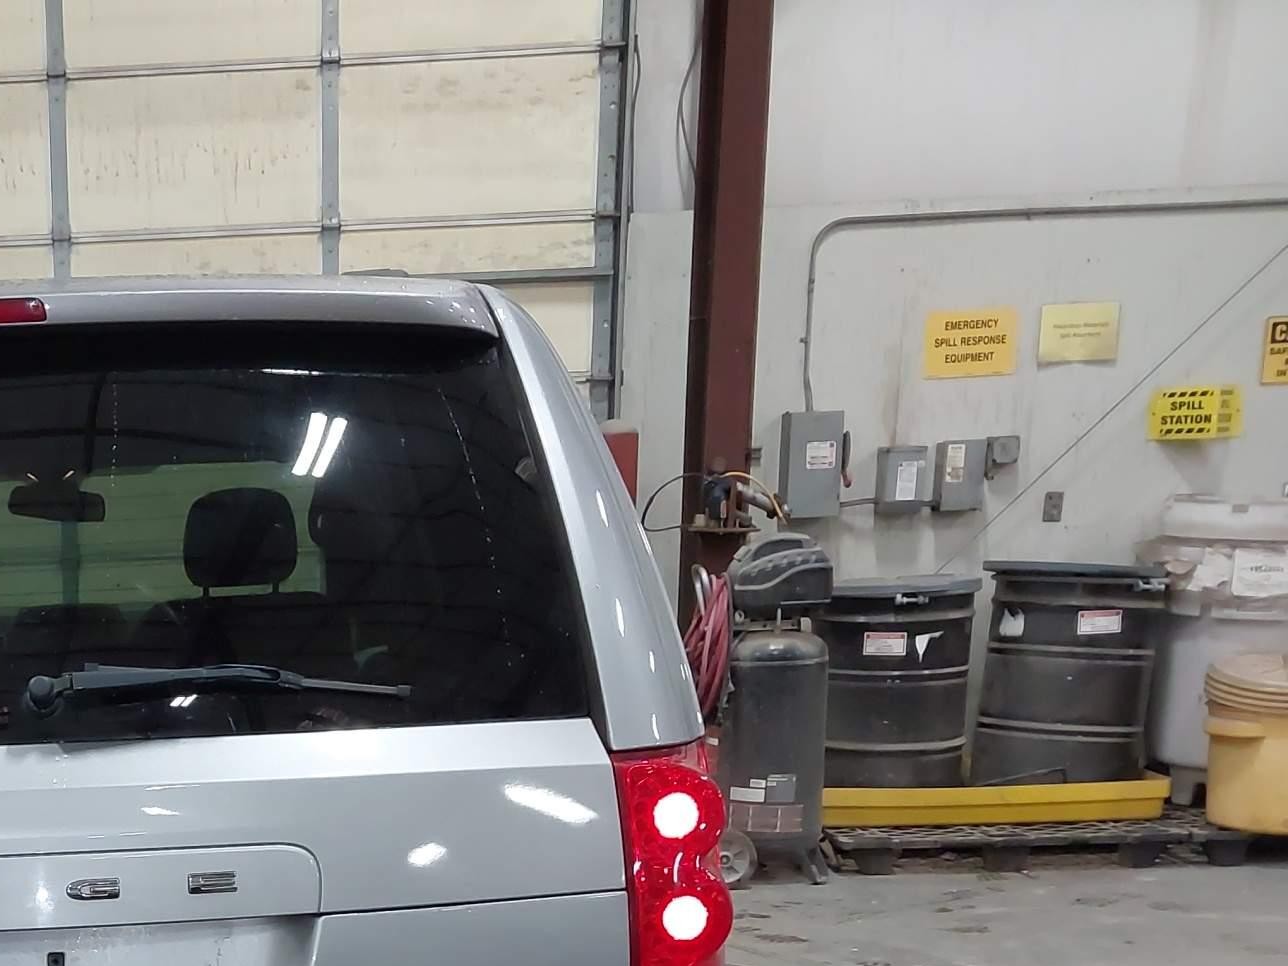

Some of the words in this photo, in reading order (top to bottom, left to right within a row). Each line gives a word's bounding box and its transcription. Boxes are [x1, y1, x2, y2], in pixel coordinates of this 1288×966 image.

[944, 318, 999, 331] EMERGENCY
[1274, 324, 1288, 341] C
[934, 336, 959, 348] SPILL
[961, 334, 1007, 347] RESPONSE
[944, 351, 994, 363] EQUIPMENT
[1170, 400, 1205, 412] SPILL
[1160, 413, 1212, 426] STATION
